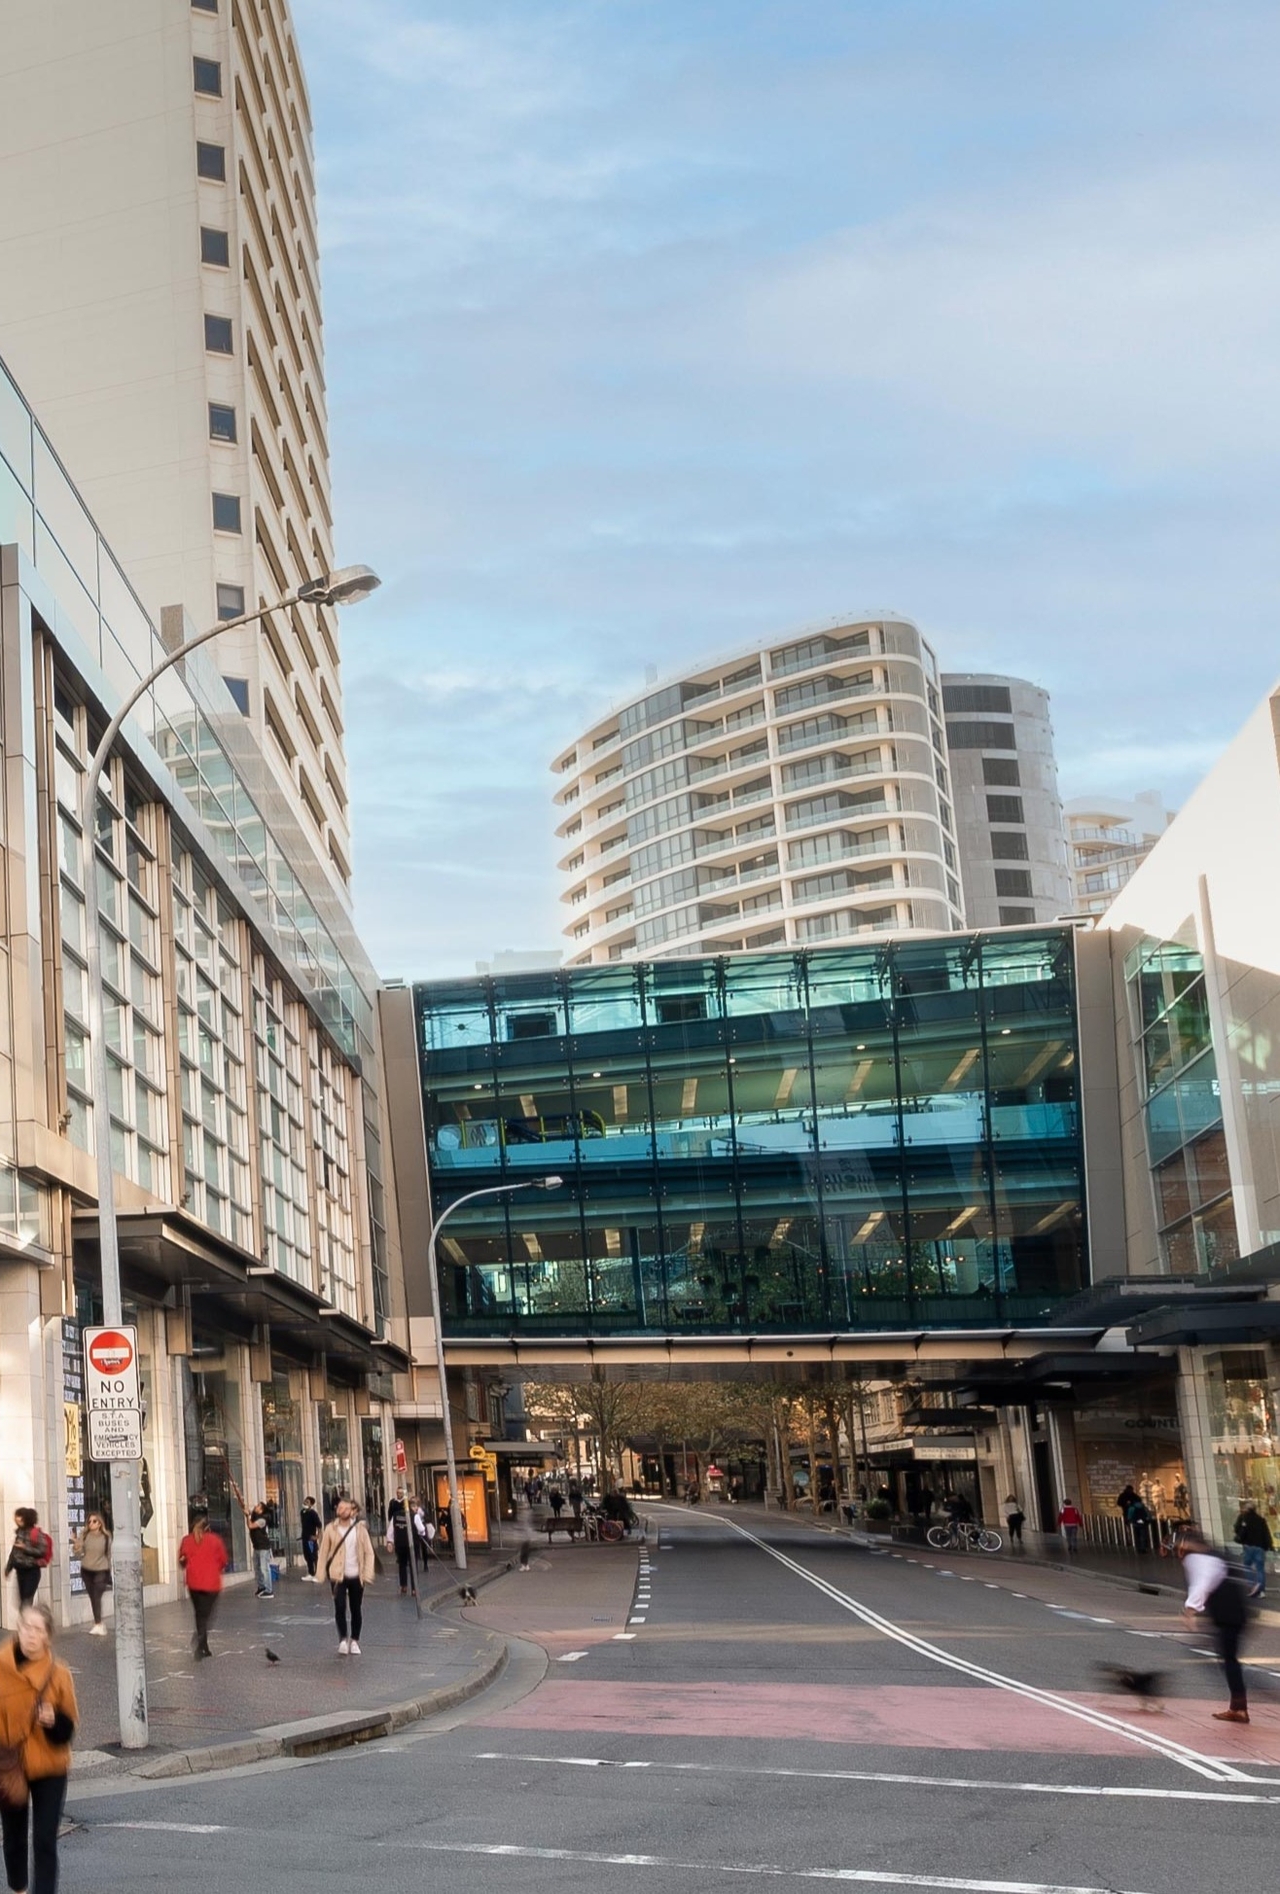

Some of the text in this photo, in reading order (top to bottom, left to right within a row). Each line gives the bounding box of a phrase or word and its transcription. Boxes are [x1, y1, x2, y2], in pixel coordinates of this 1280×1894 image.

[100, 1380, 125, 1393] NO
[92, 1397, 134, 1409] ENTRY
[96, 1441, 136, 1449] VEHICLES
